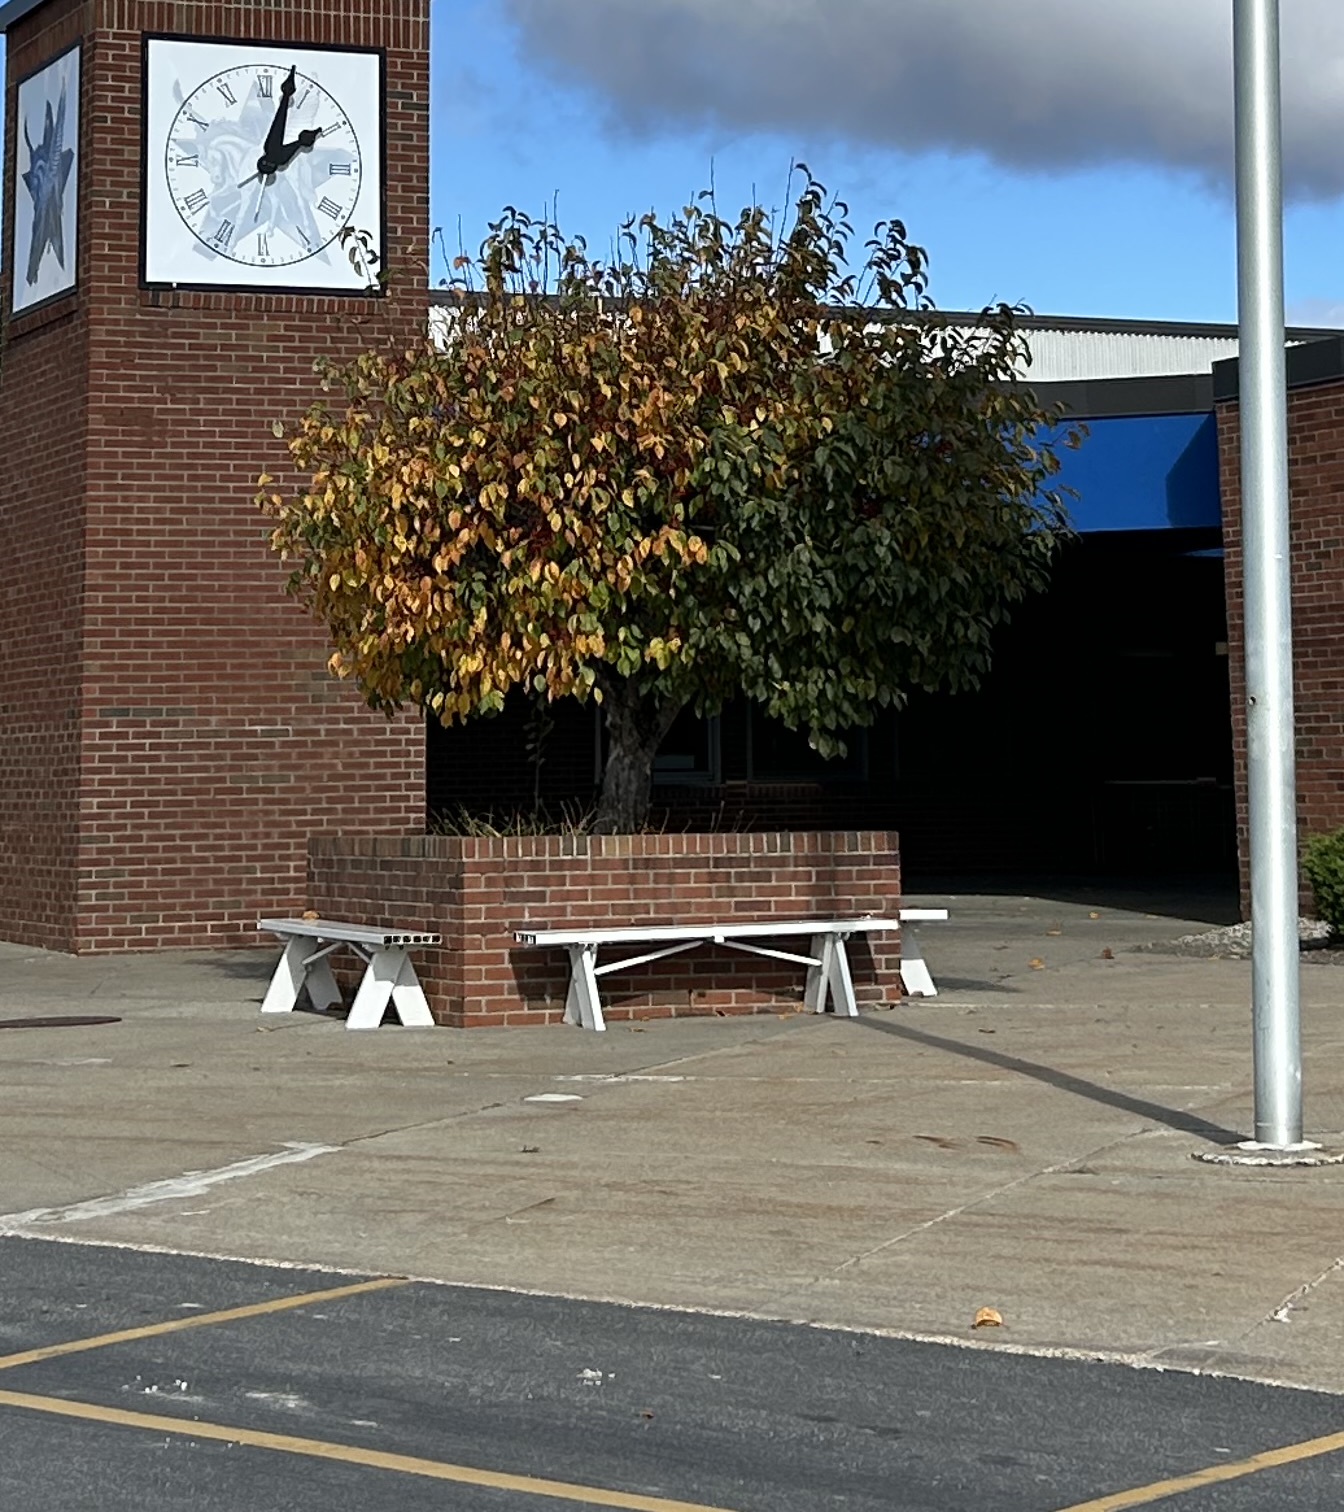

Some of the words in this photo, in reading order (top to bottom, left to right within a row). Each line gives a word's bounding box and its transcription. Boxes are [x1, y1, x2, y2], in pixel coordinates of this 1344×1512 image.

[216, 83, 237, 108] XI
[257, 74, 272, 97] XII
[296, 89, 310, 109] I
[175, 153, 199, 167] IX
[329, 163, 352, 176] III
[184, 188, 210, 215] VIII
[214, 219, 235, 246] VII
[257, 232, 270, 256] VI
